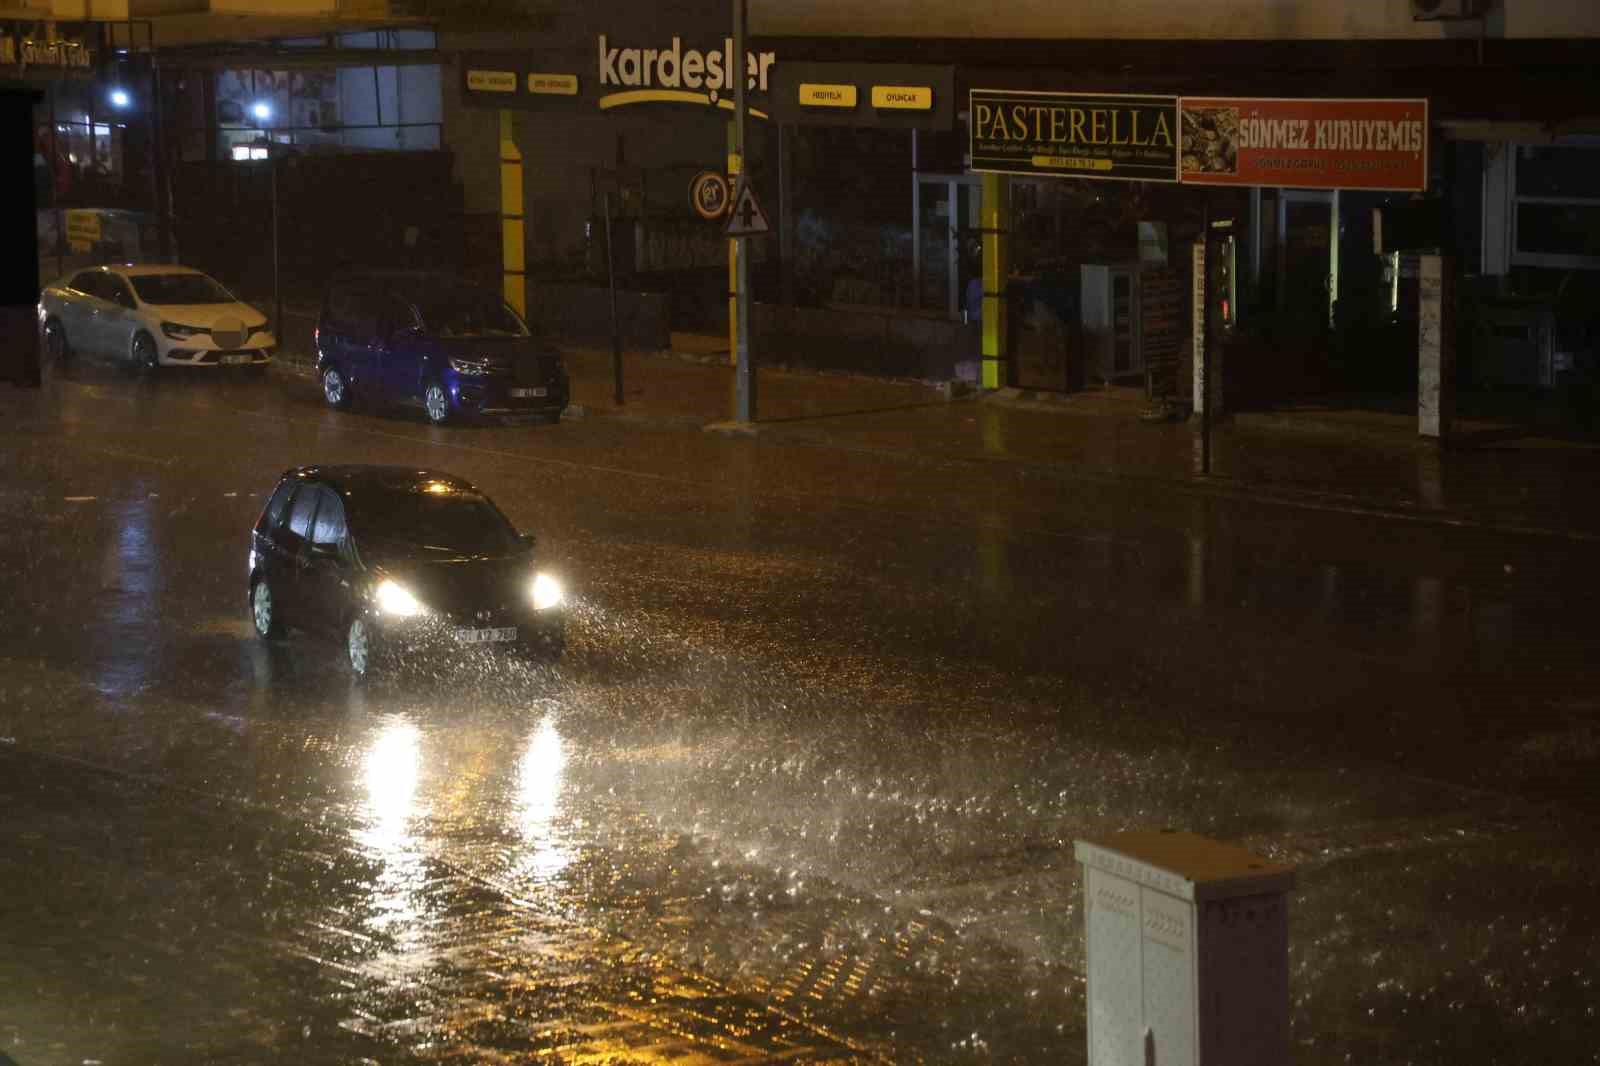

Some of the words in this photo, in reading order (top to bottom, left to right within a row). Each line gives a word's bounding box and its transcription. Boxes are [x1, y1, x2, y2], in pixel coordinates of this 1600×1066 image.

[975, 104, 1174, 146] PASTERELLA
[1239, 109, 1310, 149] SÖNMEZ
[1314, 112, 1424, 160] KURUYEMİŞ
